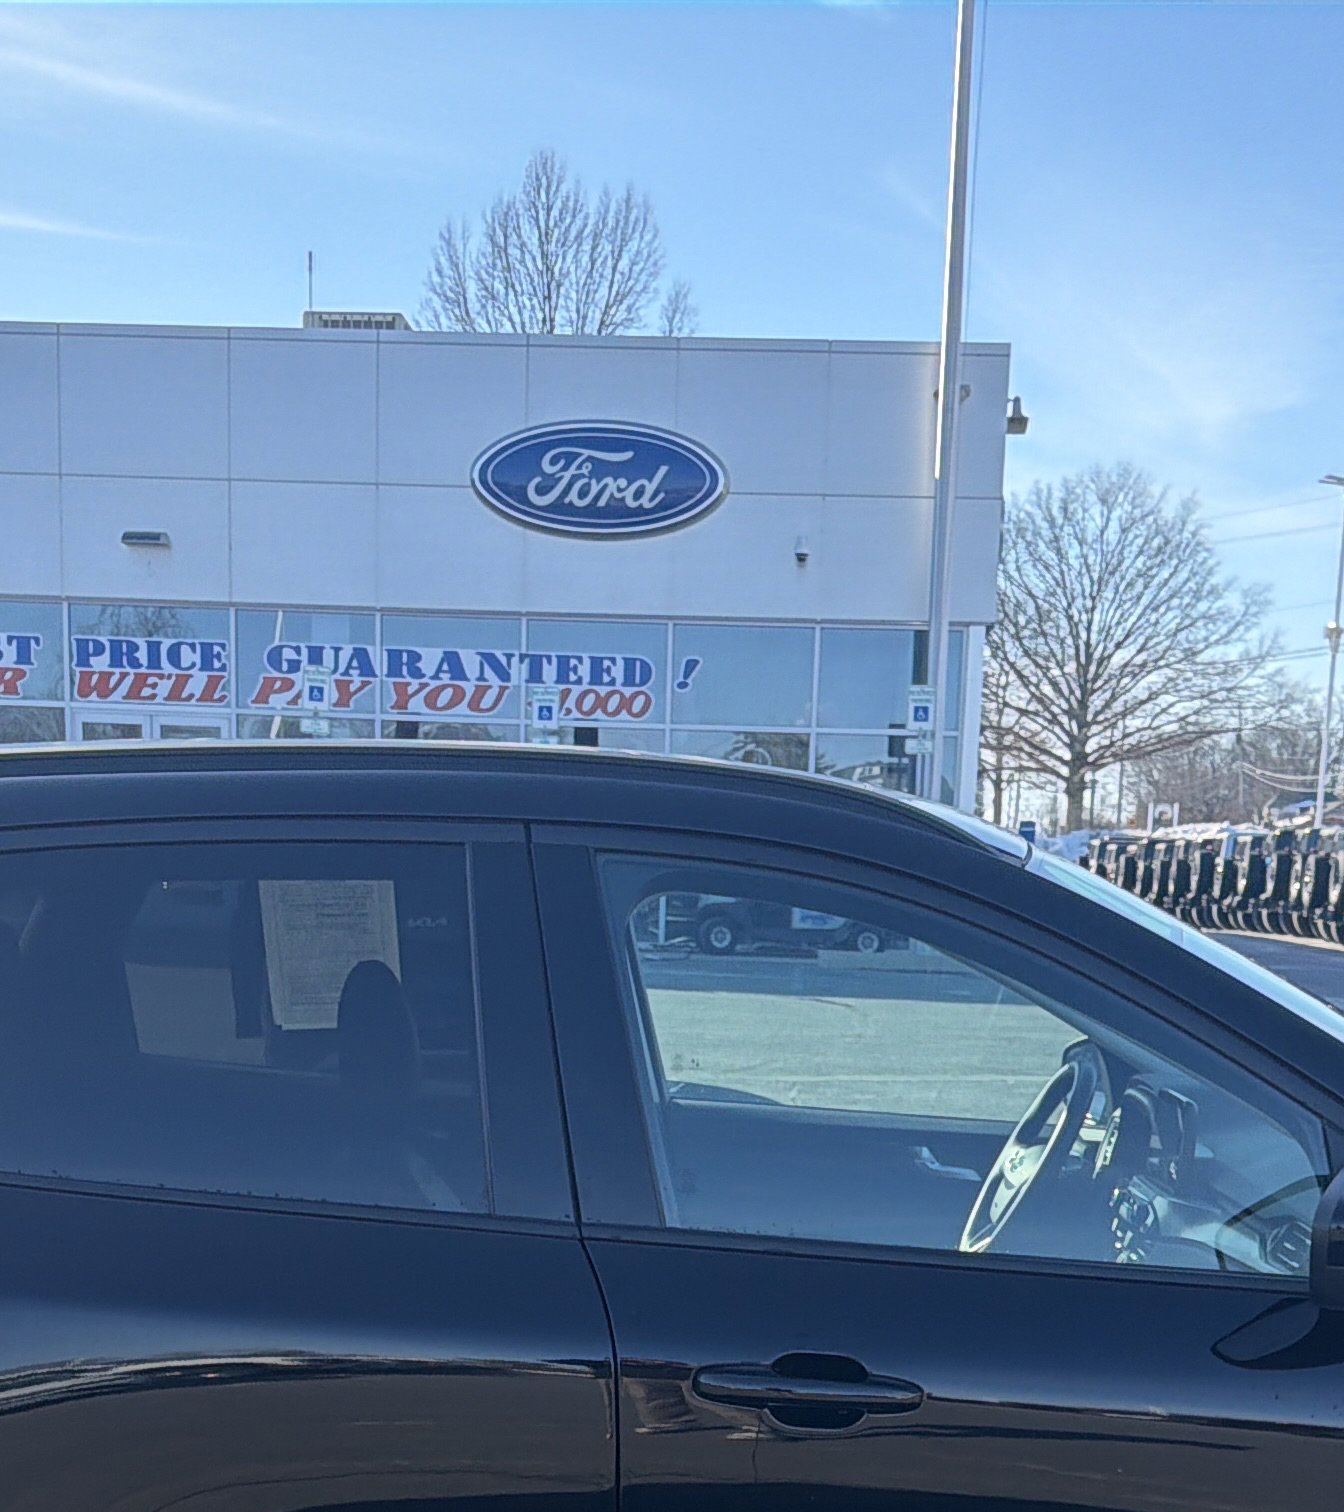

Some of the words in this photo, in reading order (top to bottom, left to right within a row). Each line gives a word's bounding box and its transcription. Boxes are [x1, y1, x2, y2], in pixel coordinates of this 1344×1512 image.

[526, 447, 669, 509] Ford
[73, 636, 229, 673] PRICE
[266, 643, 653, 688] GUARANTEED
[76, 670, 229, 703] WE'LL
[388, 681, 510, 714] YOU
